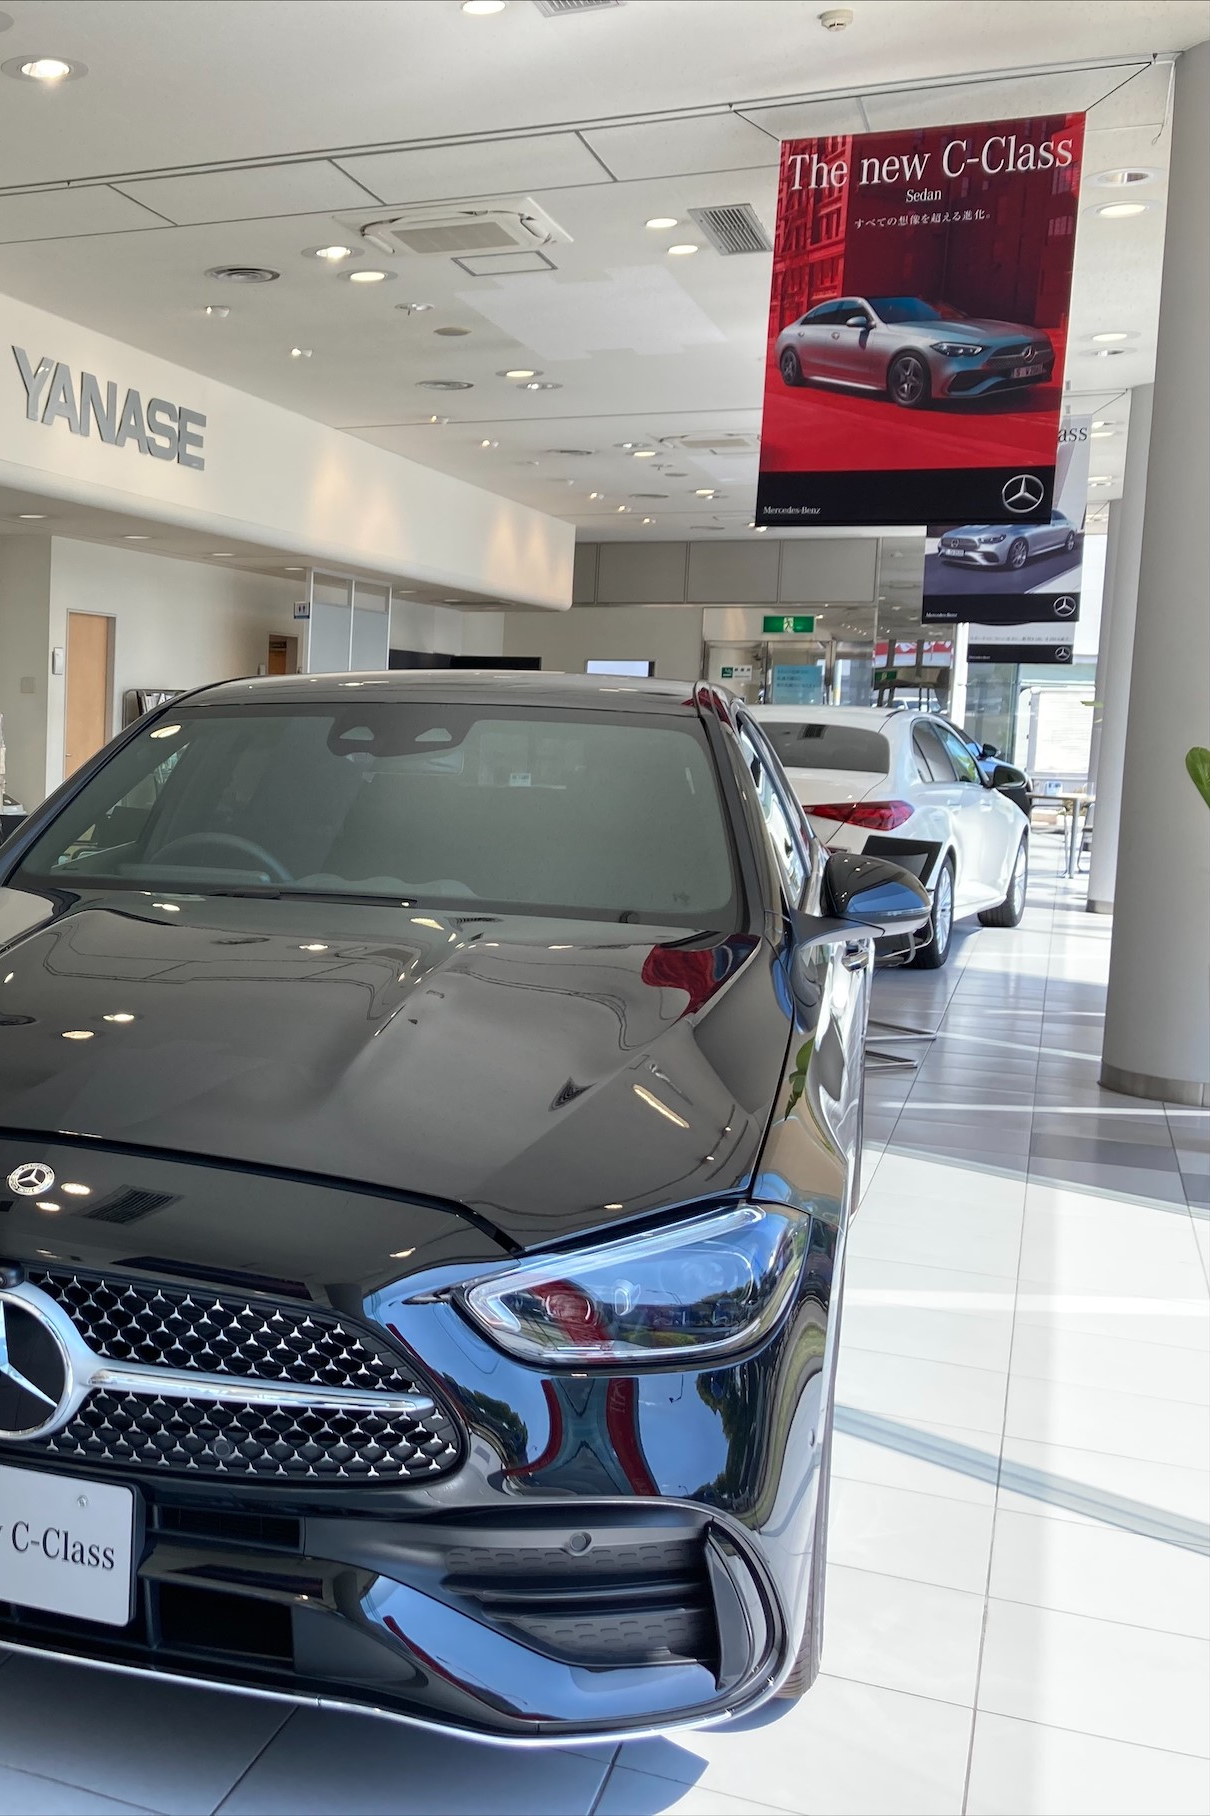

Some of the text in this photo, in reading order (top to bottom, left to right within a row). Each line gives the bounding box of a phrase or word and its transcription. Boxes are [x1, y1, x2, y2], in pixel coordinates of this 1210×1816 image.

[789, 134, 1074, 191] The new C-Class
[905, 188, 942, 203] Sedan
[854, 209, 991, 229] すべての想像を超える進化。
[11, 345, 207, 471] YANASE
[763, 505, 821, 514] Mercedes-Benz
[11, 1520, 116, 1570] C-Class
